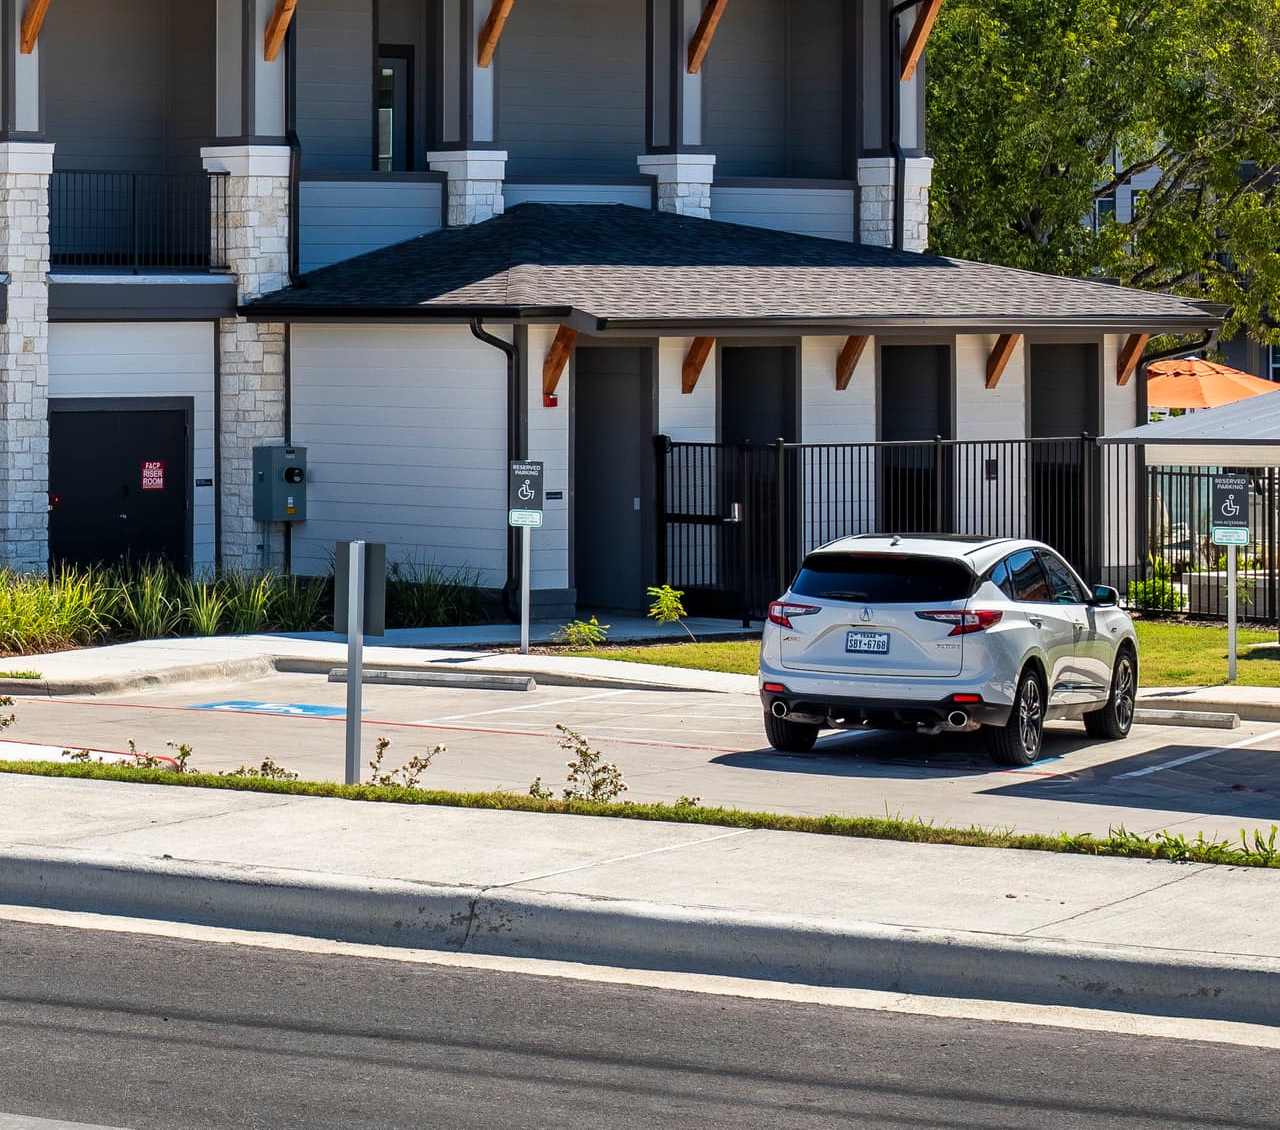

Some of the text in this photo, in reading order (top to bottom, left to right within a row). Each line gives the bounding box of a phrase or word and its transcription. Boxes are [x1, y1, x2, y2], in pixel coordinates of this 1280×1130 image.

[145, 462, 161, 470] FACP
[143, 470, 163, 478] RISER
[143, 477, 163, 486] ROOM
